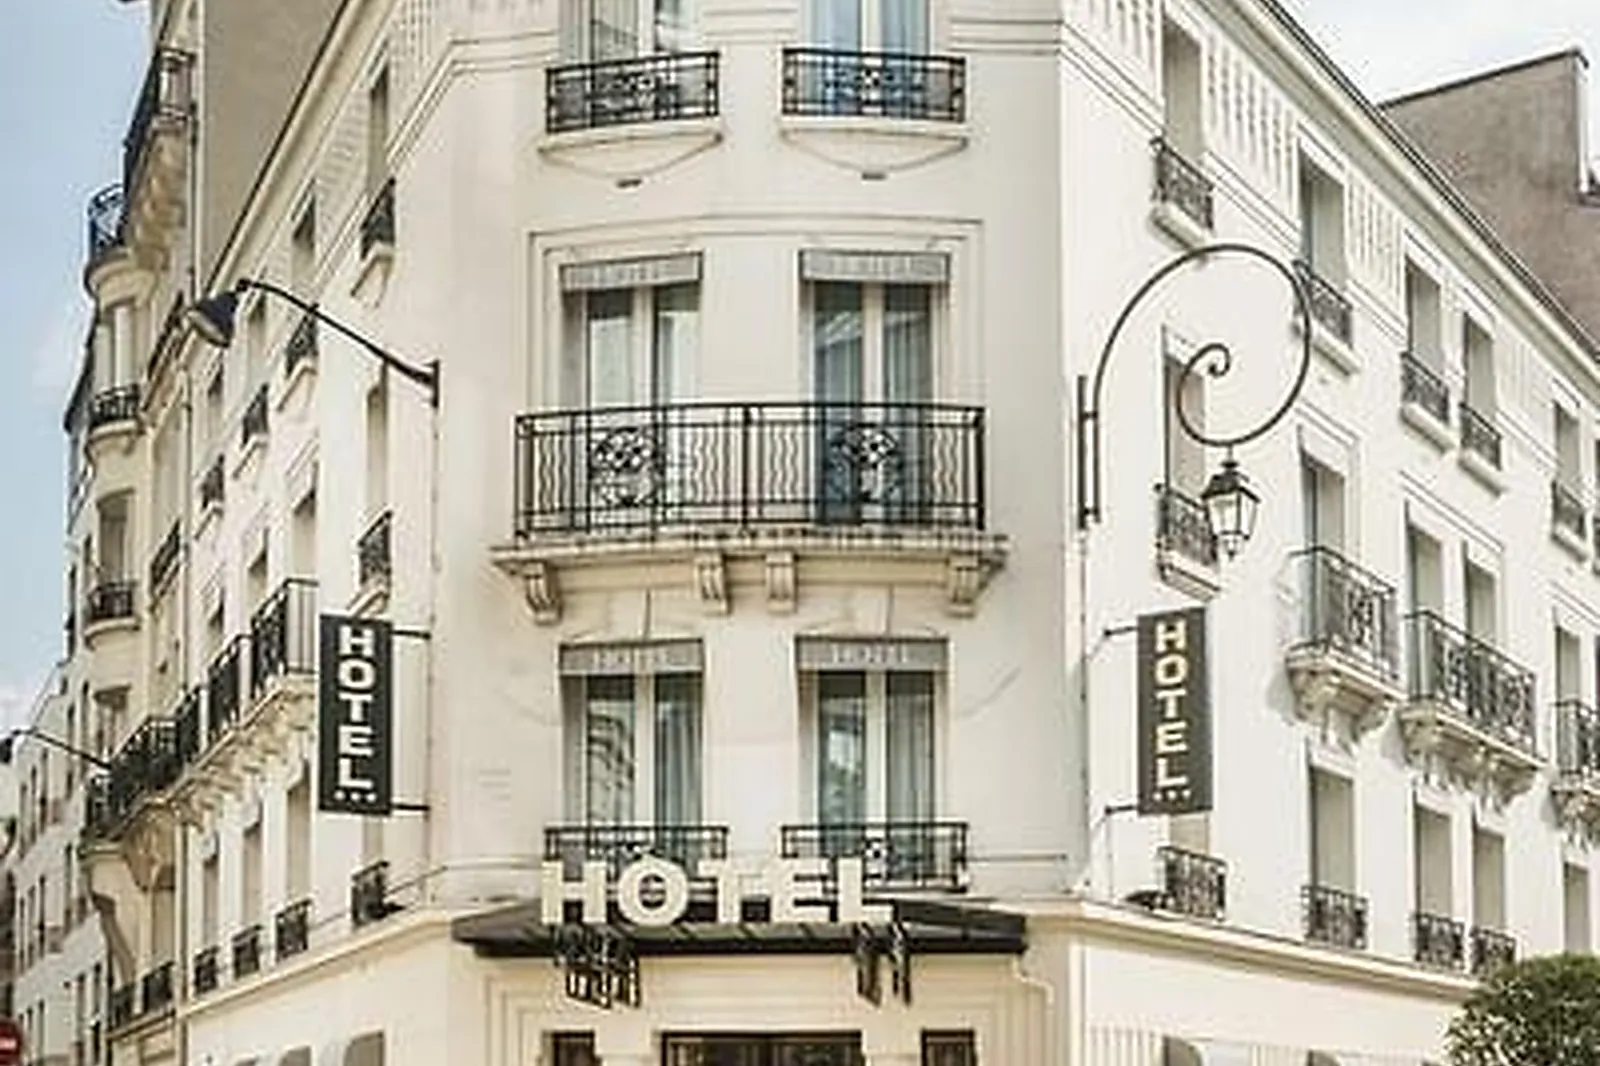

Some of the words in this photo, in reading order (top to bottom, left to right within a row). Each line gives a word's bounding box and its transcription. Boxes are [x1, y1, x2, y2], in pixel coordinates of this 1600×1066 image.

[338, 625, 376, 788] HOTEL
[1155, 619, 1188, 787] HOTEL
[541, 854, 894, 926] HOTEL
